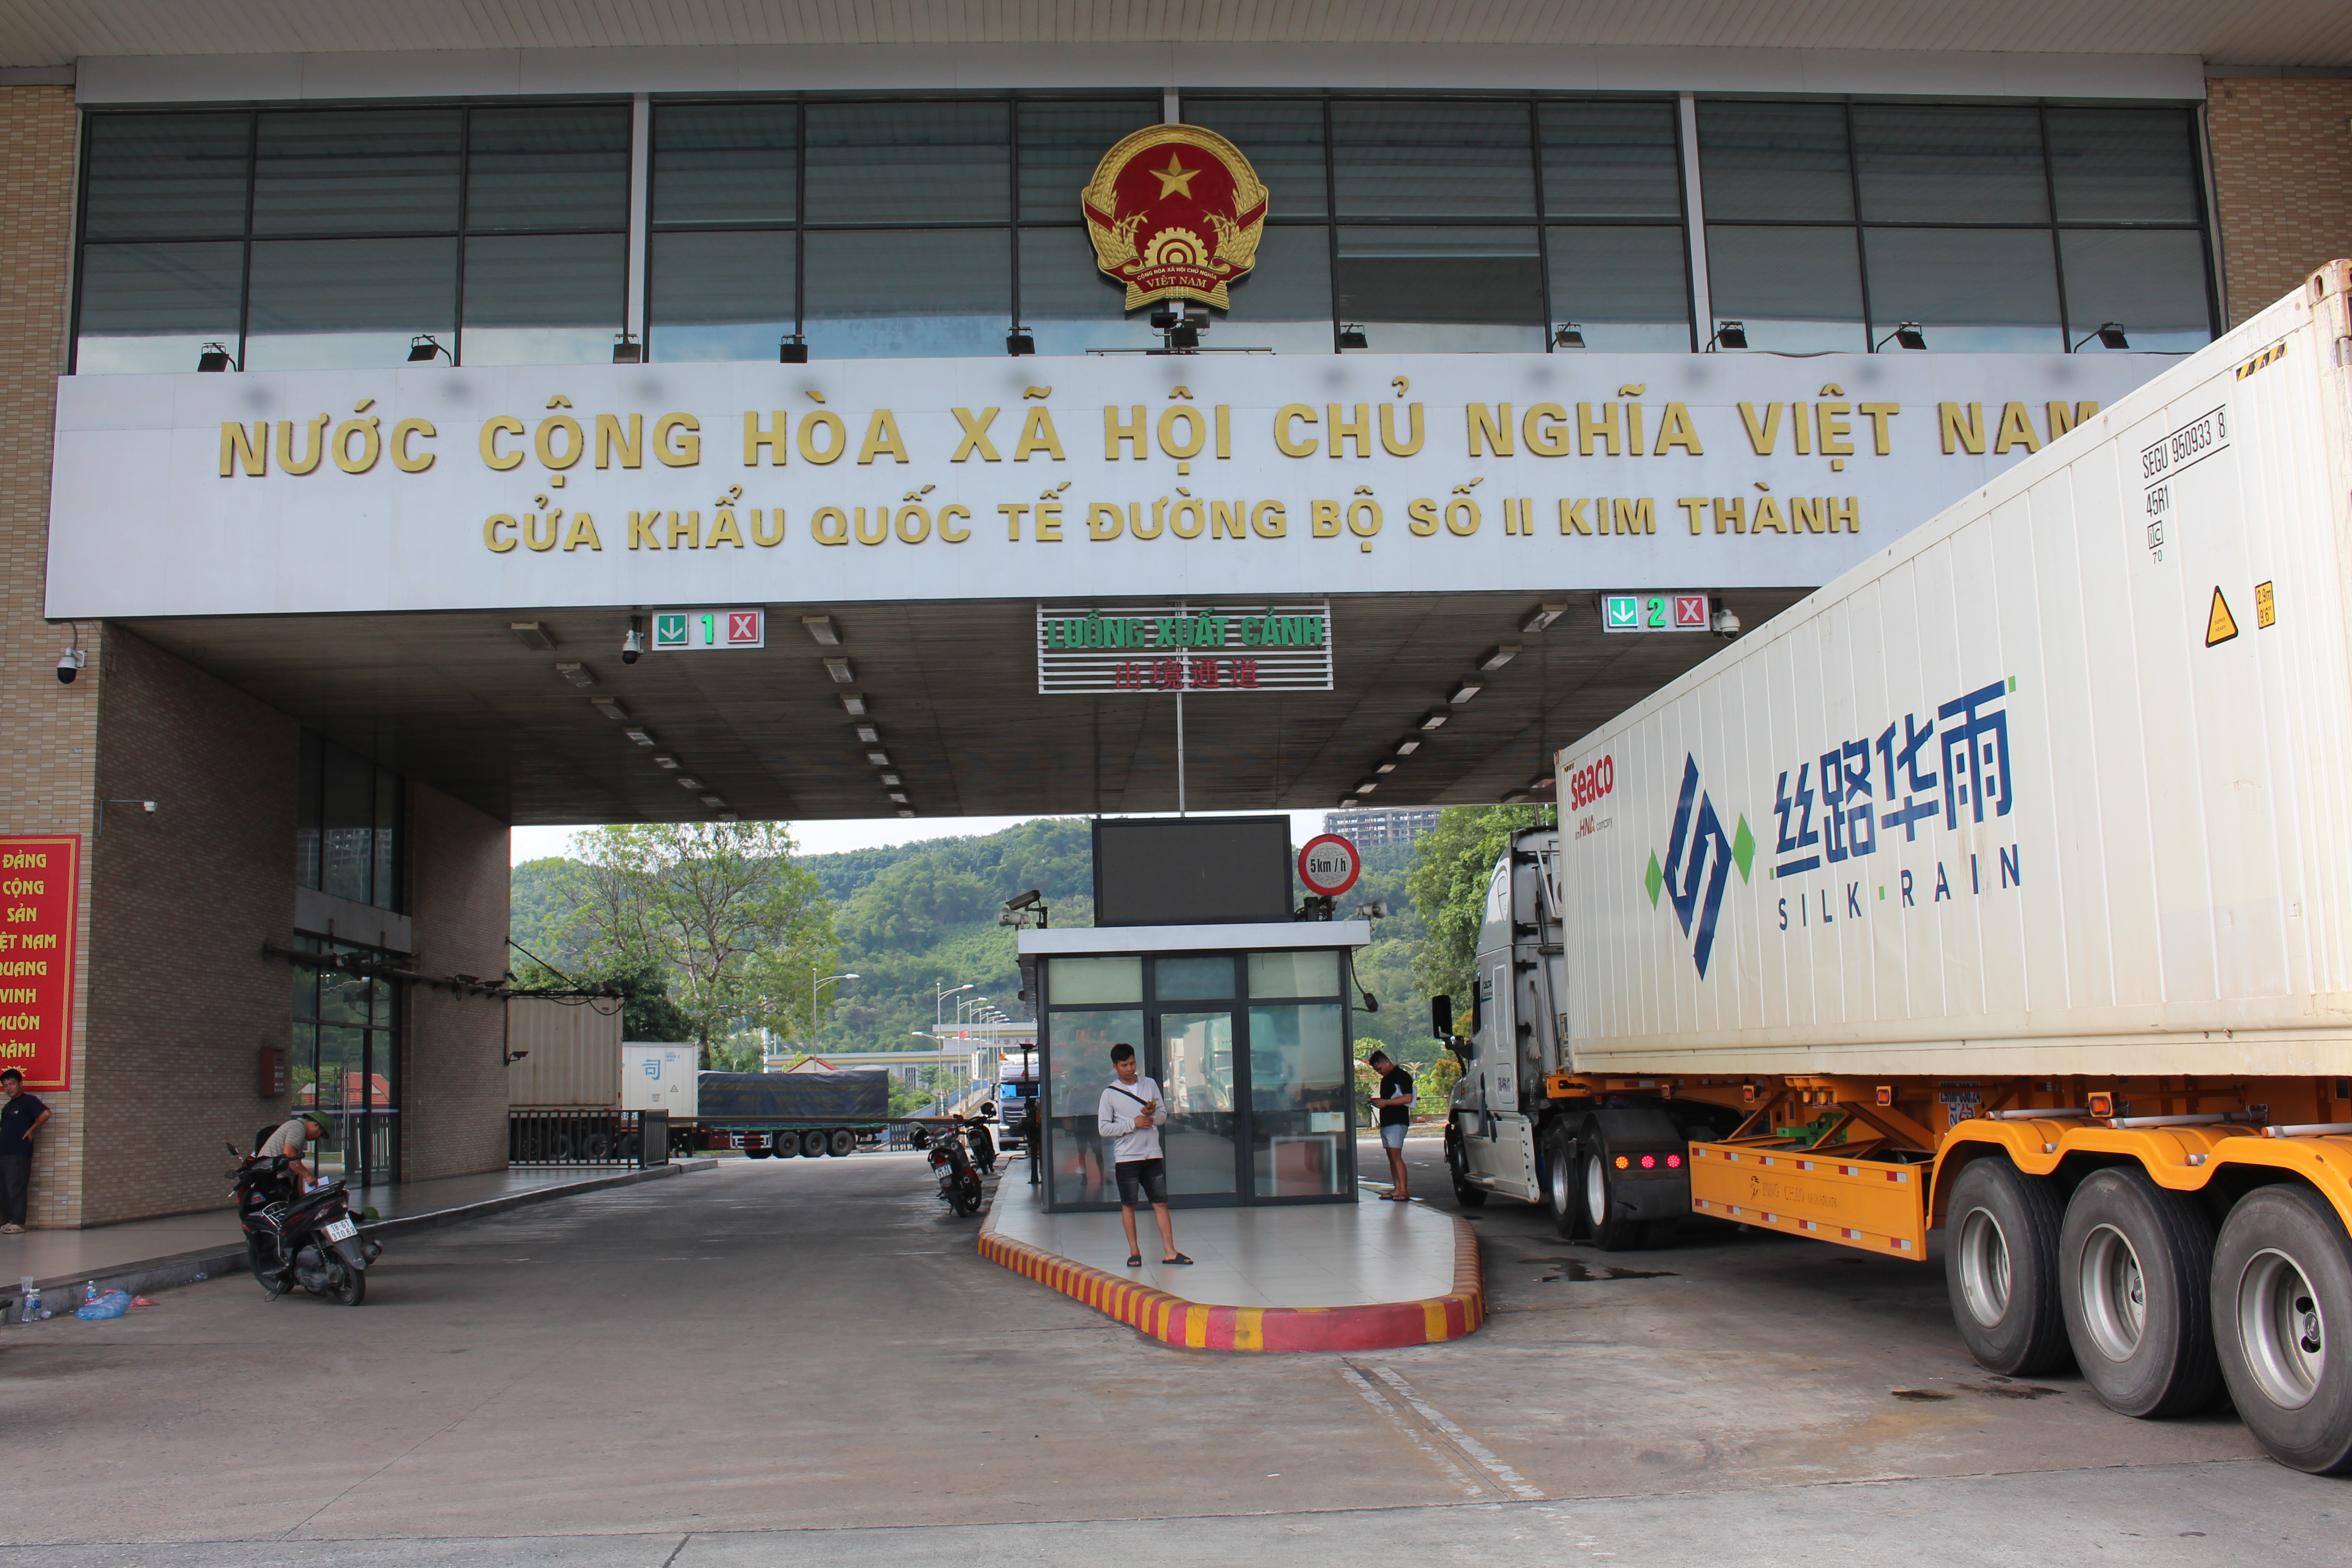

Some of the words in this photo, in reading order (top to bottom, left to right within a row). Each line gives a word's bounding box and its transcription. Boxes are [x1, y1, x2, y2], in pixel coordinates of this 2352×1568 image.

[1179, 276, 1207, 288] NAM
[219, 399, 436, 477] NƯỚC
[479, 395, 701, 487] CỘNG
[743, 391, 908, 466] HÒA
[951, 386, 1065, 462] XÃ
[1104, 386, 1230, 475] HỘI
[1275, 375, 1425, 458] CHỦ
[1467, 383, 1703, 458] NGHĨA
[1737, 383, 1900, 470] VIỆT
[2142, 443, 2168, 479] SEGU
[2172, 420, 2212, 463] 950933
[2217, 412, 2226, 438] 8
[2146, 484, 2169, 518] 45R1
[483, 494, 601, 552] CỬA
[628, 484, 784, 549] KHẨU
[811, 485, 970, 545] QUỐC
[998, 481, 1071, 542] TẾ
[1087, 487, 1286, 541] ĐƯỜNG
[1311, 485, 1383, 553] BỘ
[1408, 477, 1483, 537] SỐ
[1505, 498, 1533, 536] II
[1560, 497, 1656, 536] KIM
[1679, 482, 1860, 534] THÀNH
[2152, 549, 2163, 565] 70
[1648, 597, 1666, 627] 2
[2215, 617, 2225, 625] SUPER
[701, 614, 713, 644] 1
[1048, 608, 1145, 648] LUỒNG
[1154, 608, 1229, 647] XUẤT
[1241, 606, 1323, 646] CẢNH
[1115, 657, 1260, 690] 出境通道
[1571, 755, 1613, 811] seaco
[1774, 680, 2013, 879] 丝路华雨
[2, 849, 47, 870] ĐẢNG
[3, 877, 44, 898] CỘNG
[7, 903, 37, 923] SẢN
[0, 931, 18, 952] ỆT
[22, 934, 57, 950] NAM
[0, 988, 37, 1004] VINH
[0, 1039, 36, 1059] NĂM!
[642, 1059, 661, 1081] 司
[1784, 1185, 1804, 1203] CHAO
[330, 1220, 349, 1232] 18-G1
[332, 1226, 356, 1241] 310.63
